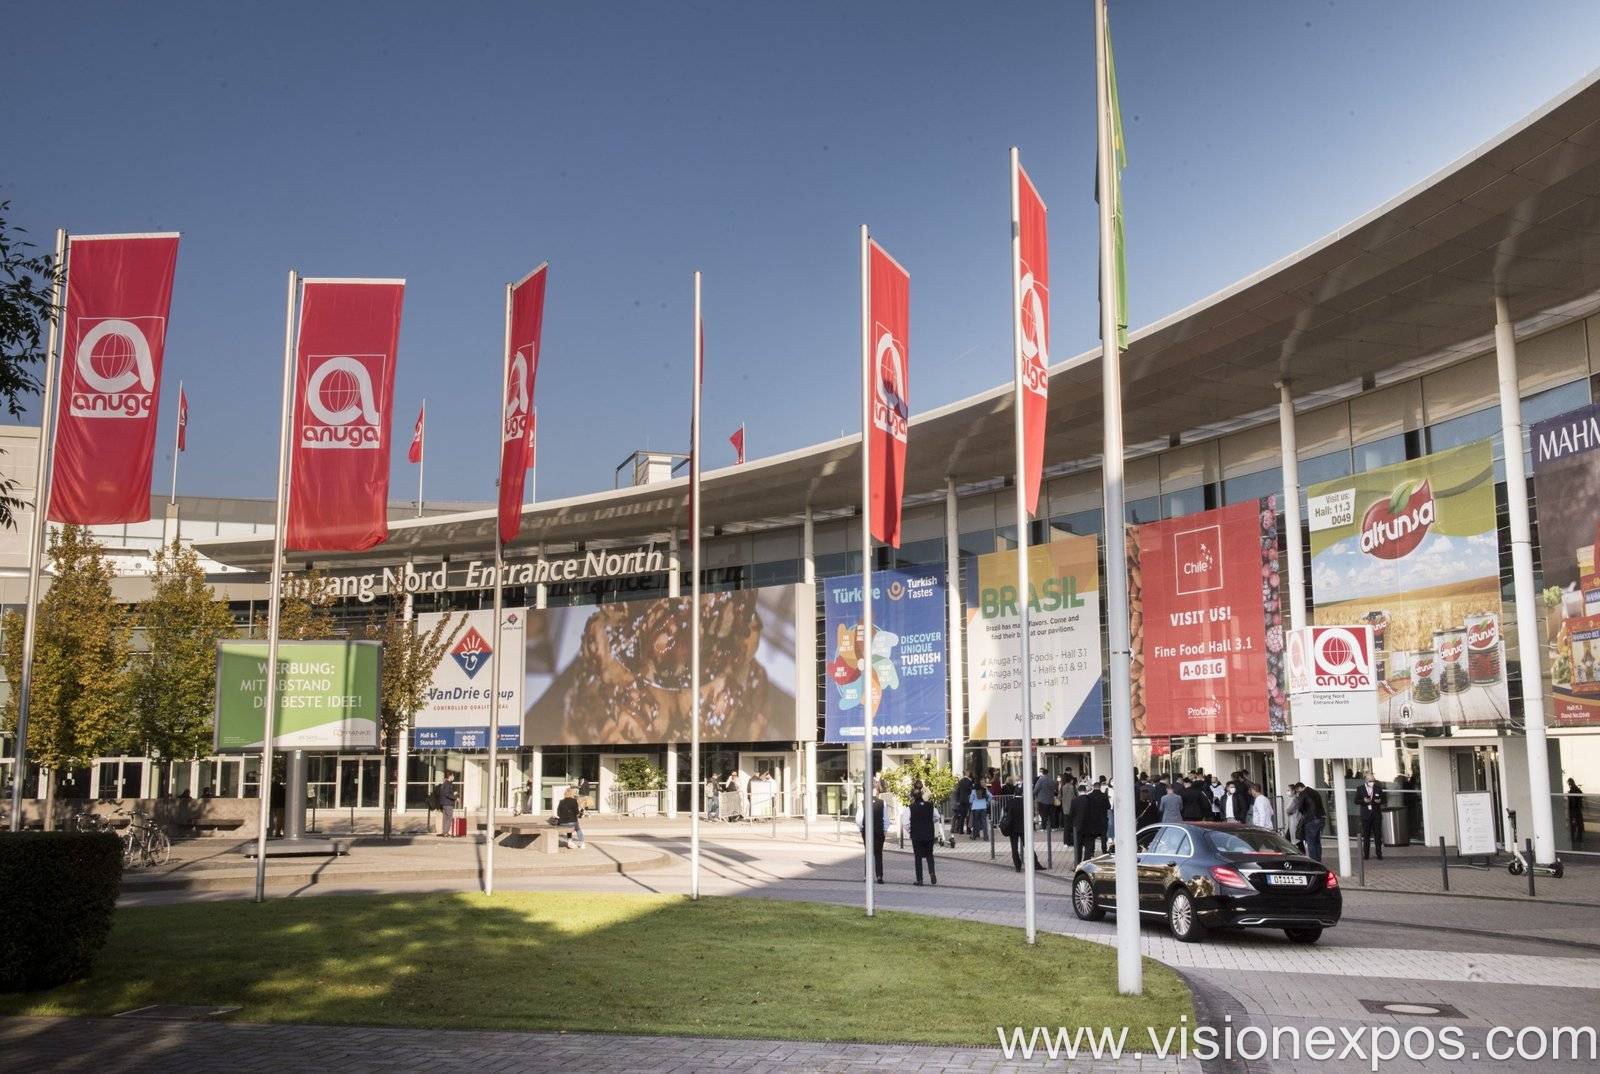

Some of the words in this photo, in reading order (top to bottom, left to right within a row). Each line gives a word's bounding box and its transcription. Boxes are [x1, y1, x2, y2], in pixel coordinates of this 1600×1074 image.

[303, 426, 380, 447] anuga
[1315, 507, 1332, 518] Hall:
[1334, 502, 1351, 513] 11.3
[1360, 499, 1436, 553] altunsa
[465, 559, 577, 589] Entrance
[583, 546, 664, 578] North
[1184, 561, 1208, 574] Chile
[382, 561, 447, 594] Nord
[907, 576, 938, 588] Turkish
[833, 586, 881, 603] Türkie
[908, 589, 934, 599] Tastes
[982, 576, 1085, 620] BRASIL
[1170, 610, 1205, 626] VISIT
[1210, 606, 1232, 621] US!
[901, 632, 941, 645] DISCOVER
[901, 643, 932, 654] UNIQUE
[1061, 648, 1075, 659] Hall
[1155, 646, 1176, 658] Fine
[1180, 642, 1205, 656] Food
[1209, 639, 1231, 653] Hall
[1235, 637, 1252, 650] 3.1
[901, 652, 941, 666] TURKISH
[901, 664, 935, 677] TASTES
[1038, 665, 1056, 674] Halls
[1070, 662, 1076, 671] &
[1182, 662, 1223, 677] A-081G
[240, 680, 266, 692] MIT
[1045, 679, 1060, 687] Hall
[1316, 675, 1370, 689] anuga
[428, 686, 480, 700] VanDrie
[484, 689, 514, 699] Gup
[254, 696, 268, 708] DI
[281, 696, 322, 708] BESTE
[327, 696, 362, 708] IDEE!
